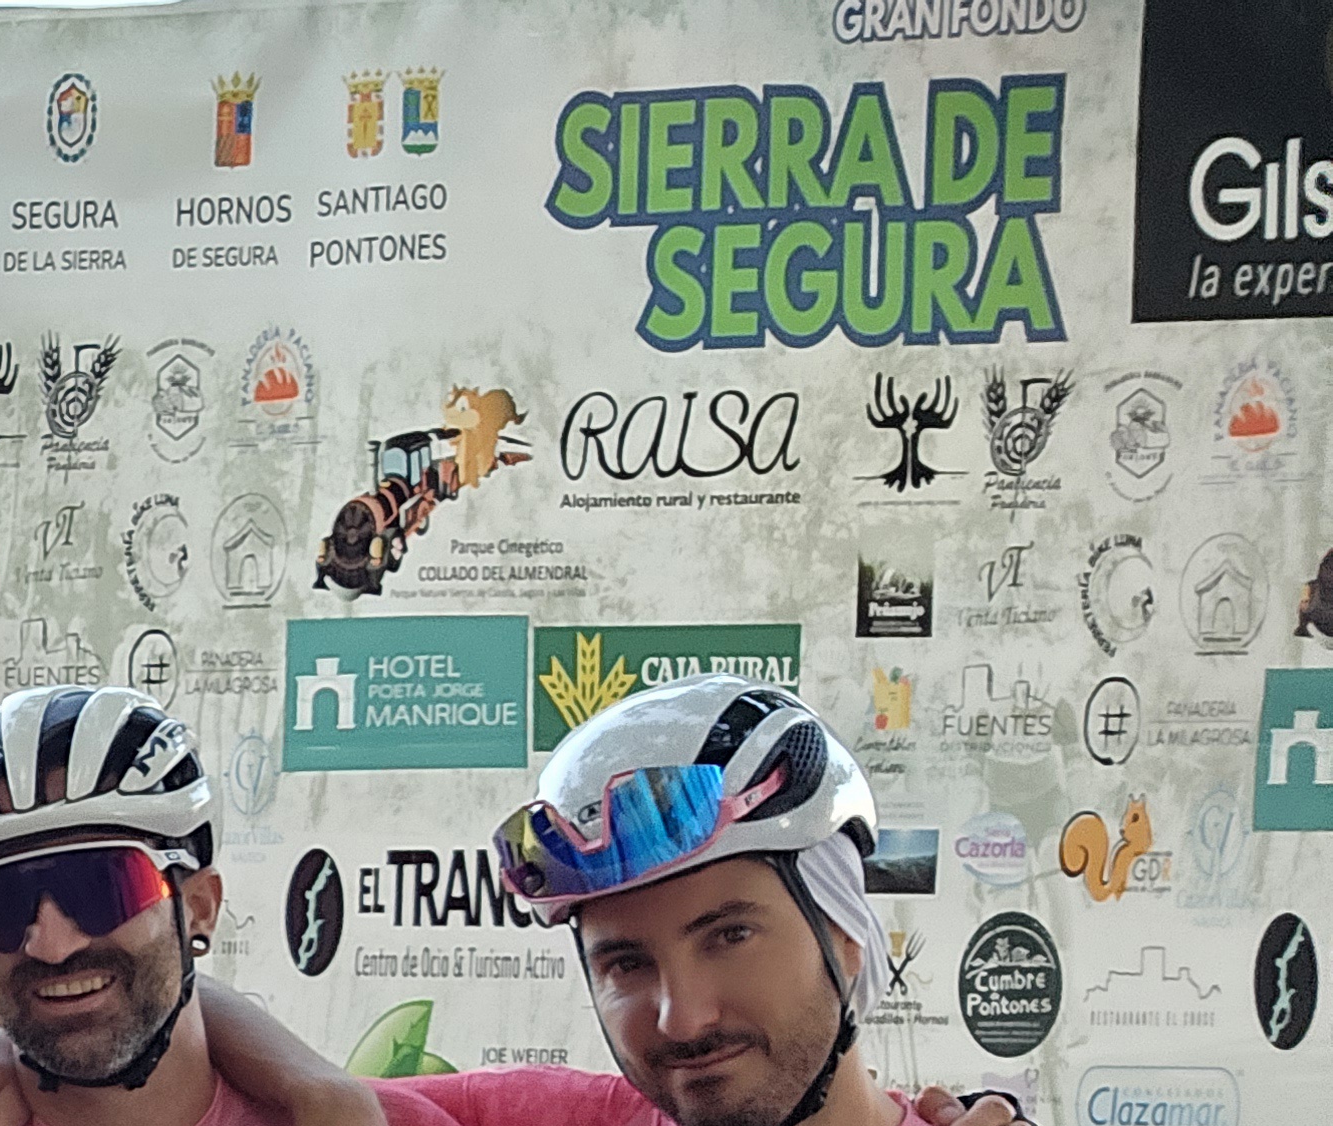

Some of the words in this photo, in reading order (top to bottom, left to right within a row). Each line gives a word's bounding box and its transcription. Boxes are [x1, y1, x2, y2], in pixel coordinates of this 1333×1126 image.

[834, 0, 942, 43] GRAN
[949, 0, 1086, 36] FONDO
[551, 88, 910, 222] SIERRA
[930, 80, 1063, 211] DE
[176, 195, 292, 227] HORNOS
[317, 184, 448, 217] SANTIAGO
[11, 201, 119, 230] SEGURA
[3, 251, 30, 273] DE
[32, 250, 57, 272] LA
[60, 249, 127, 271] SIERRA
[172, 248, 198, 269] DE
[201, 245, 279, 267] SEGURA
[310, 234, 447, 269] PONTONES
[640, 214, 1061, 347] SEGURA
[1188, 254, 1222, 299] la
[559, 492, 651, 512] Alojamiento
[656, 491, 693, 507] rural
[697, 494, 707, 510] y
[710, 490, 801, 505] restaurante
[451, 539, 494, 557] Parque
[418, 566, 478, 581] COLLADO
[482, 566, 506, 581] DEL
[5, 666, 101, 687] FUENTES
[369, 655, 461, 679] HOTEL
[368, 682, 426, 698] POETA
[432, 682, 484, 698] JORGE
[365, 702, 518, 727] MANRIQUE
[942, 715, 1052, 736] FUENTES
[954, 837, 1026, 858] Cazorla
[359, 868, 385, 913] EL
[355, 946, 397, 977] Centro
[402, 946, 418, 977] de
[421, 947, 449, 978] Ocio
[468, 947, 520, 979] Turismo
[524, 947, 565, 979] Activo
[975, 972, 1046, 992] Cumbre
[966, 994, 1052, 1017] Pontones
[481, 1048, 507, 1065] JOE
[511, 1047, 569, 1065] WEIDER
